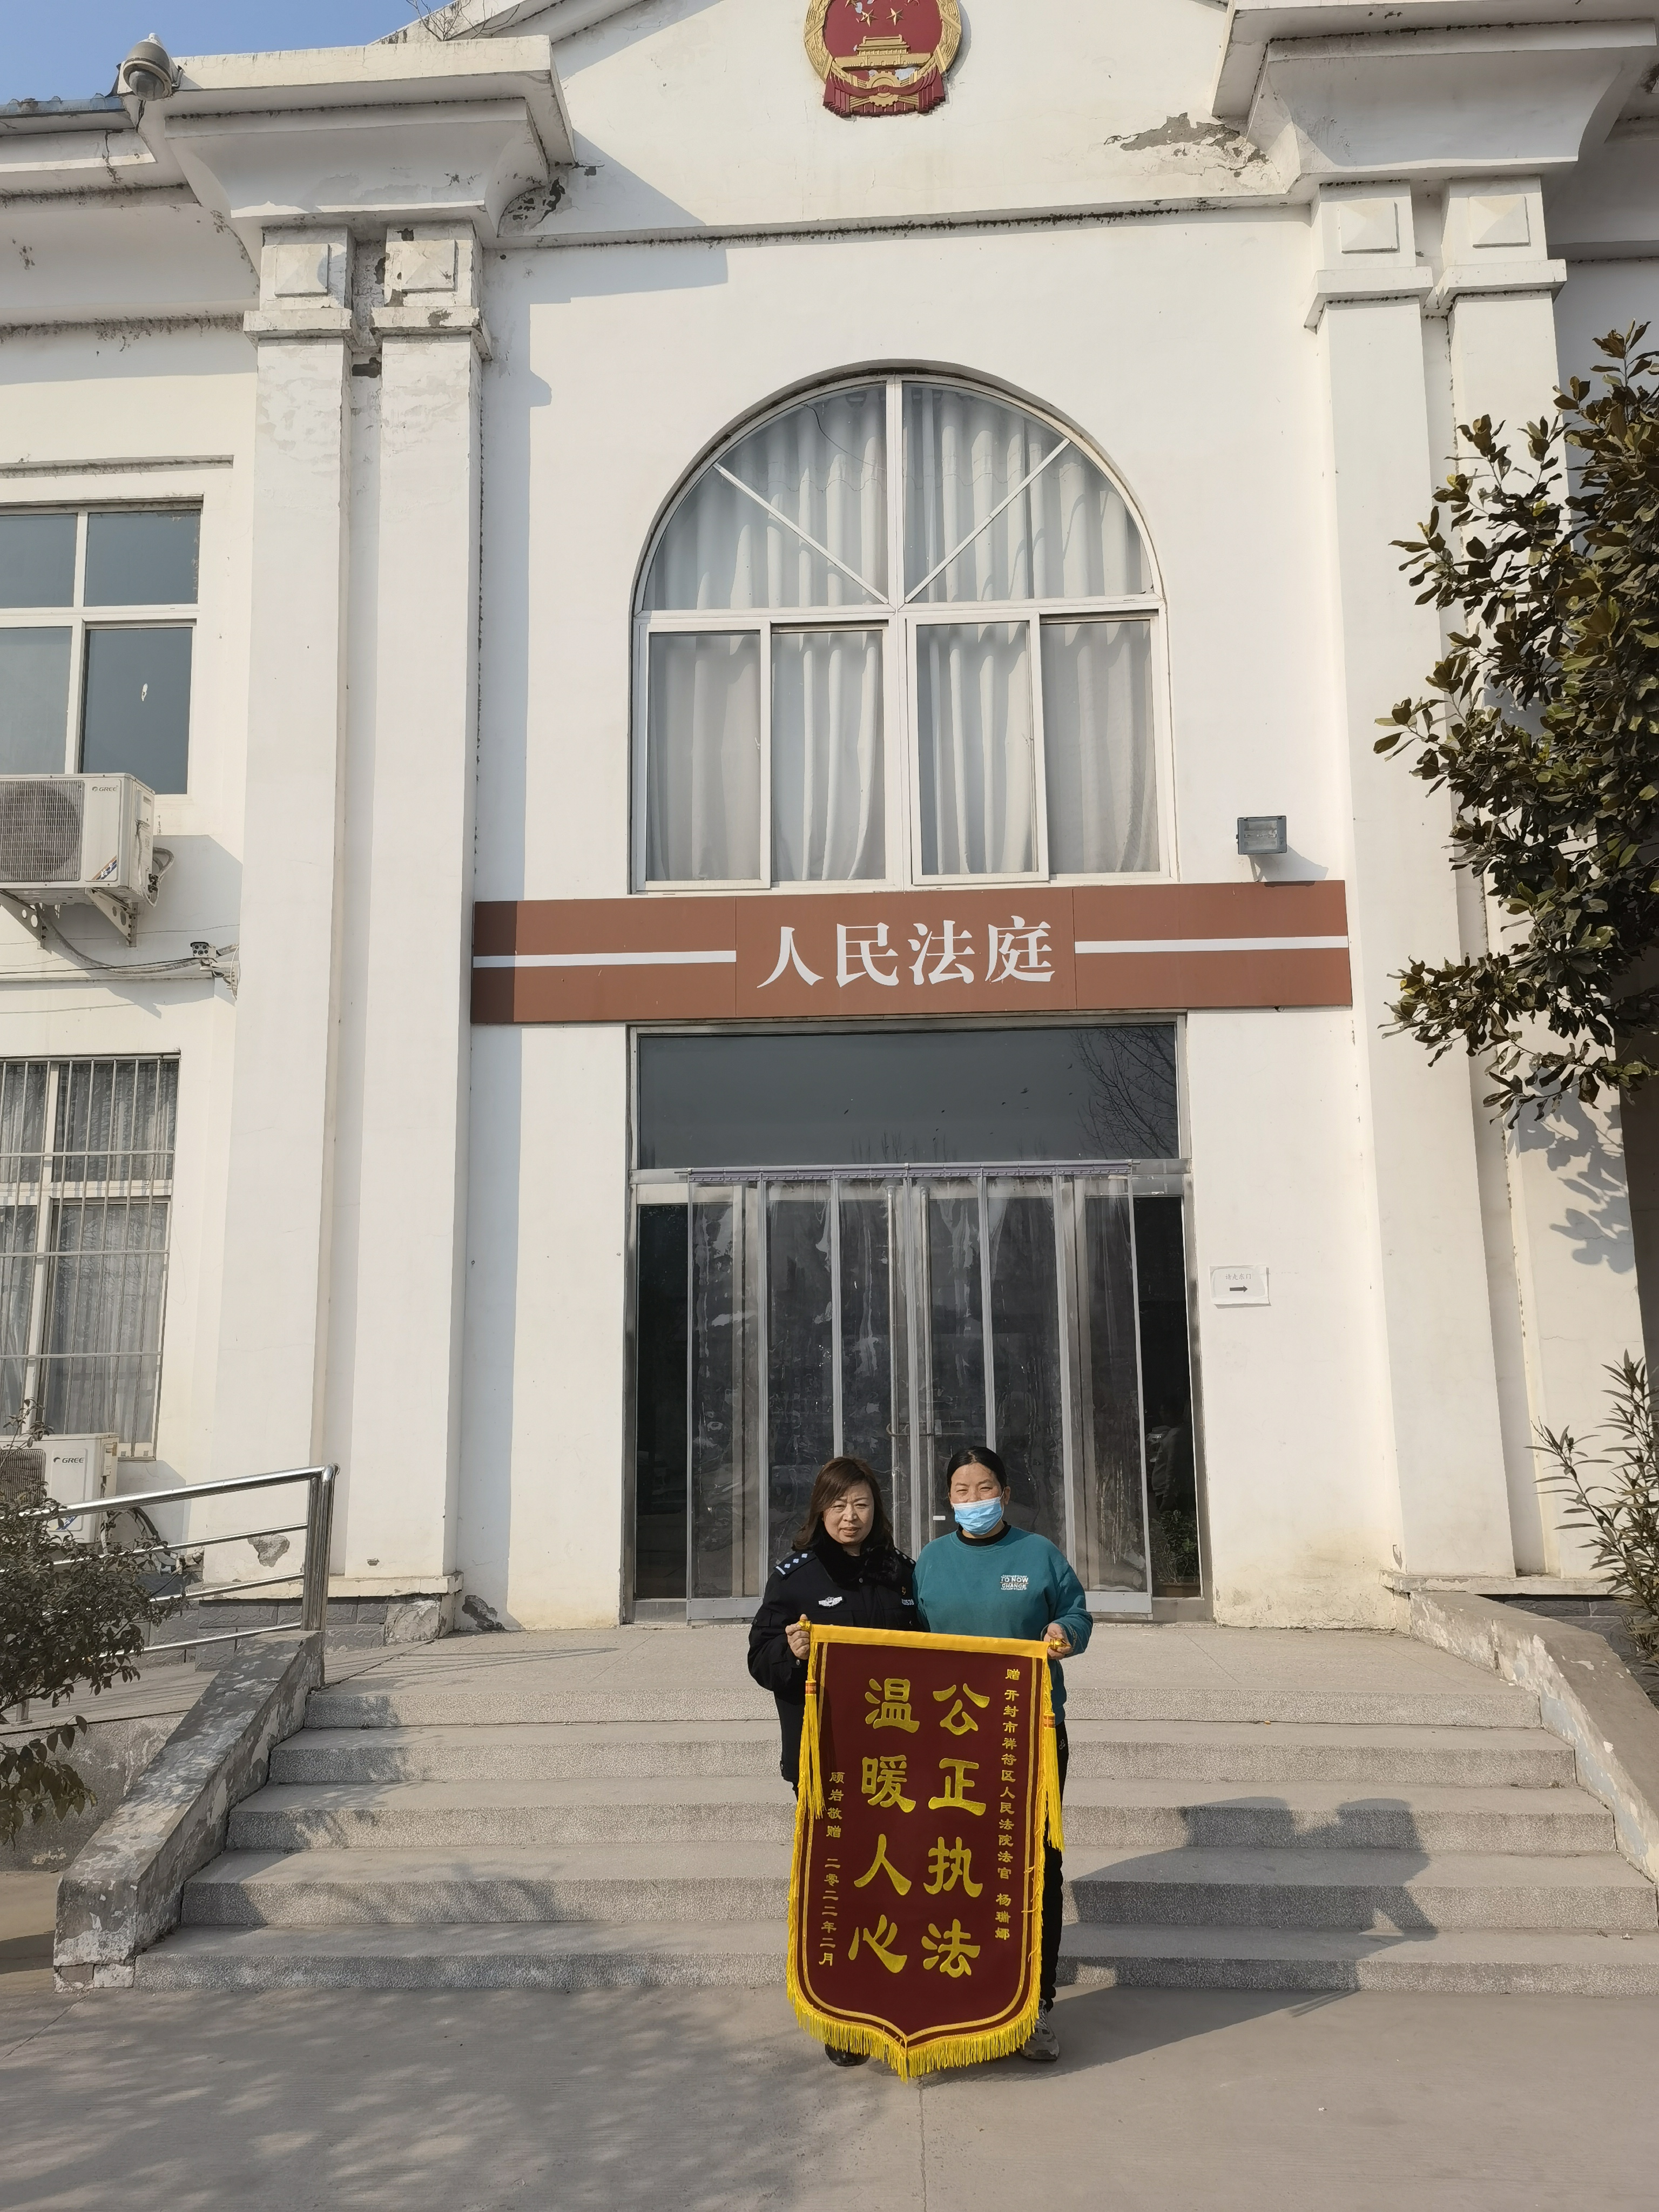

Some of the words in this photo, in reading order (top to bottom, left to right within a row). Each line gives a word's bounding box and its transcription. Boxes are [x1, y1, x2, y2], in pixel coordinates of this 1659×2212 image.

[756, 915, 1056, 988] 人民法庭
[826, 1772, 845, 1838] 顾岩敬赠
[848, 1678, 920, 1973] 温暖人心
[921, 1683, 990, 1978] 公正执法
[998, 1690, 1019, 1879] 开封市祥符区人民法院法官
[819, 1858, 840, 1966] 二零二二年二月
